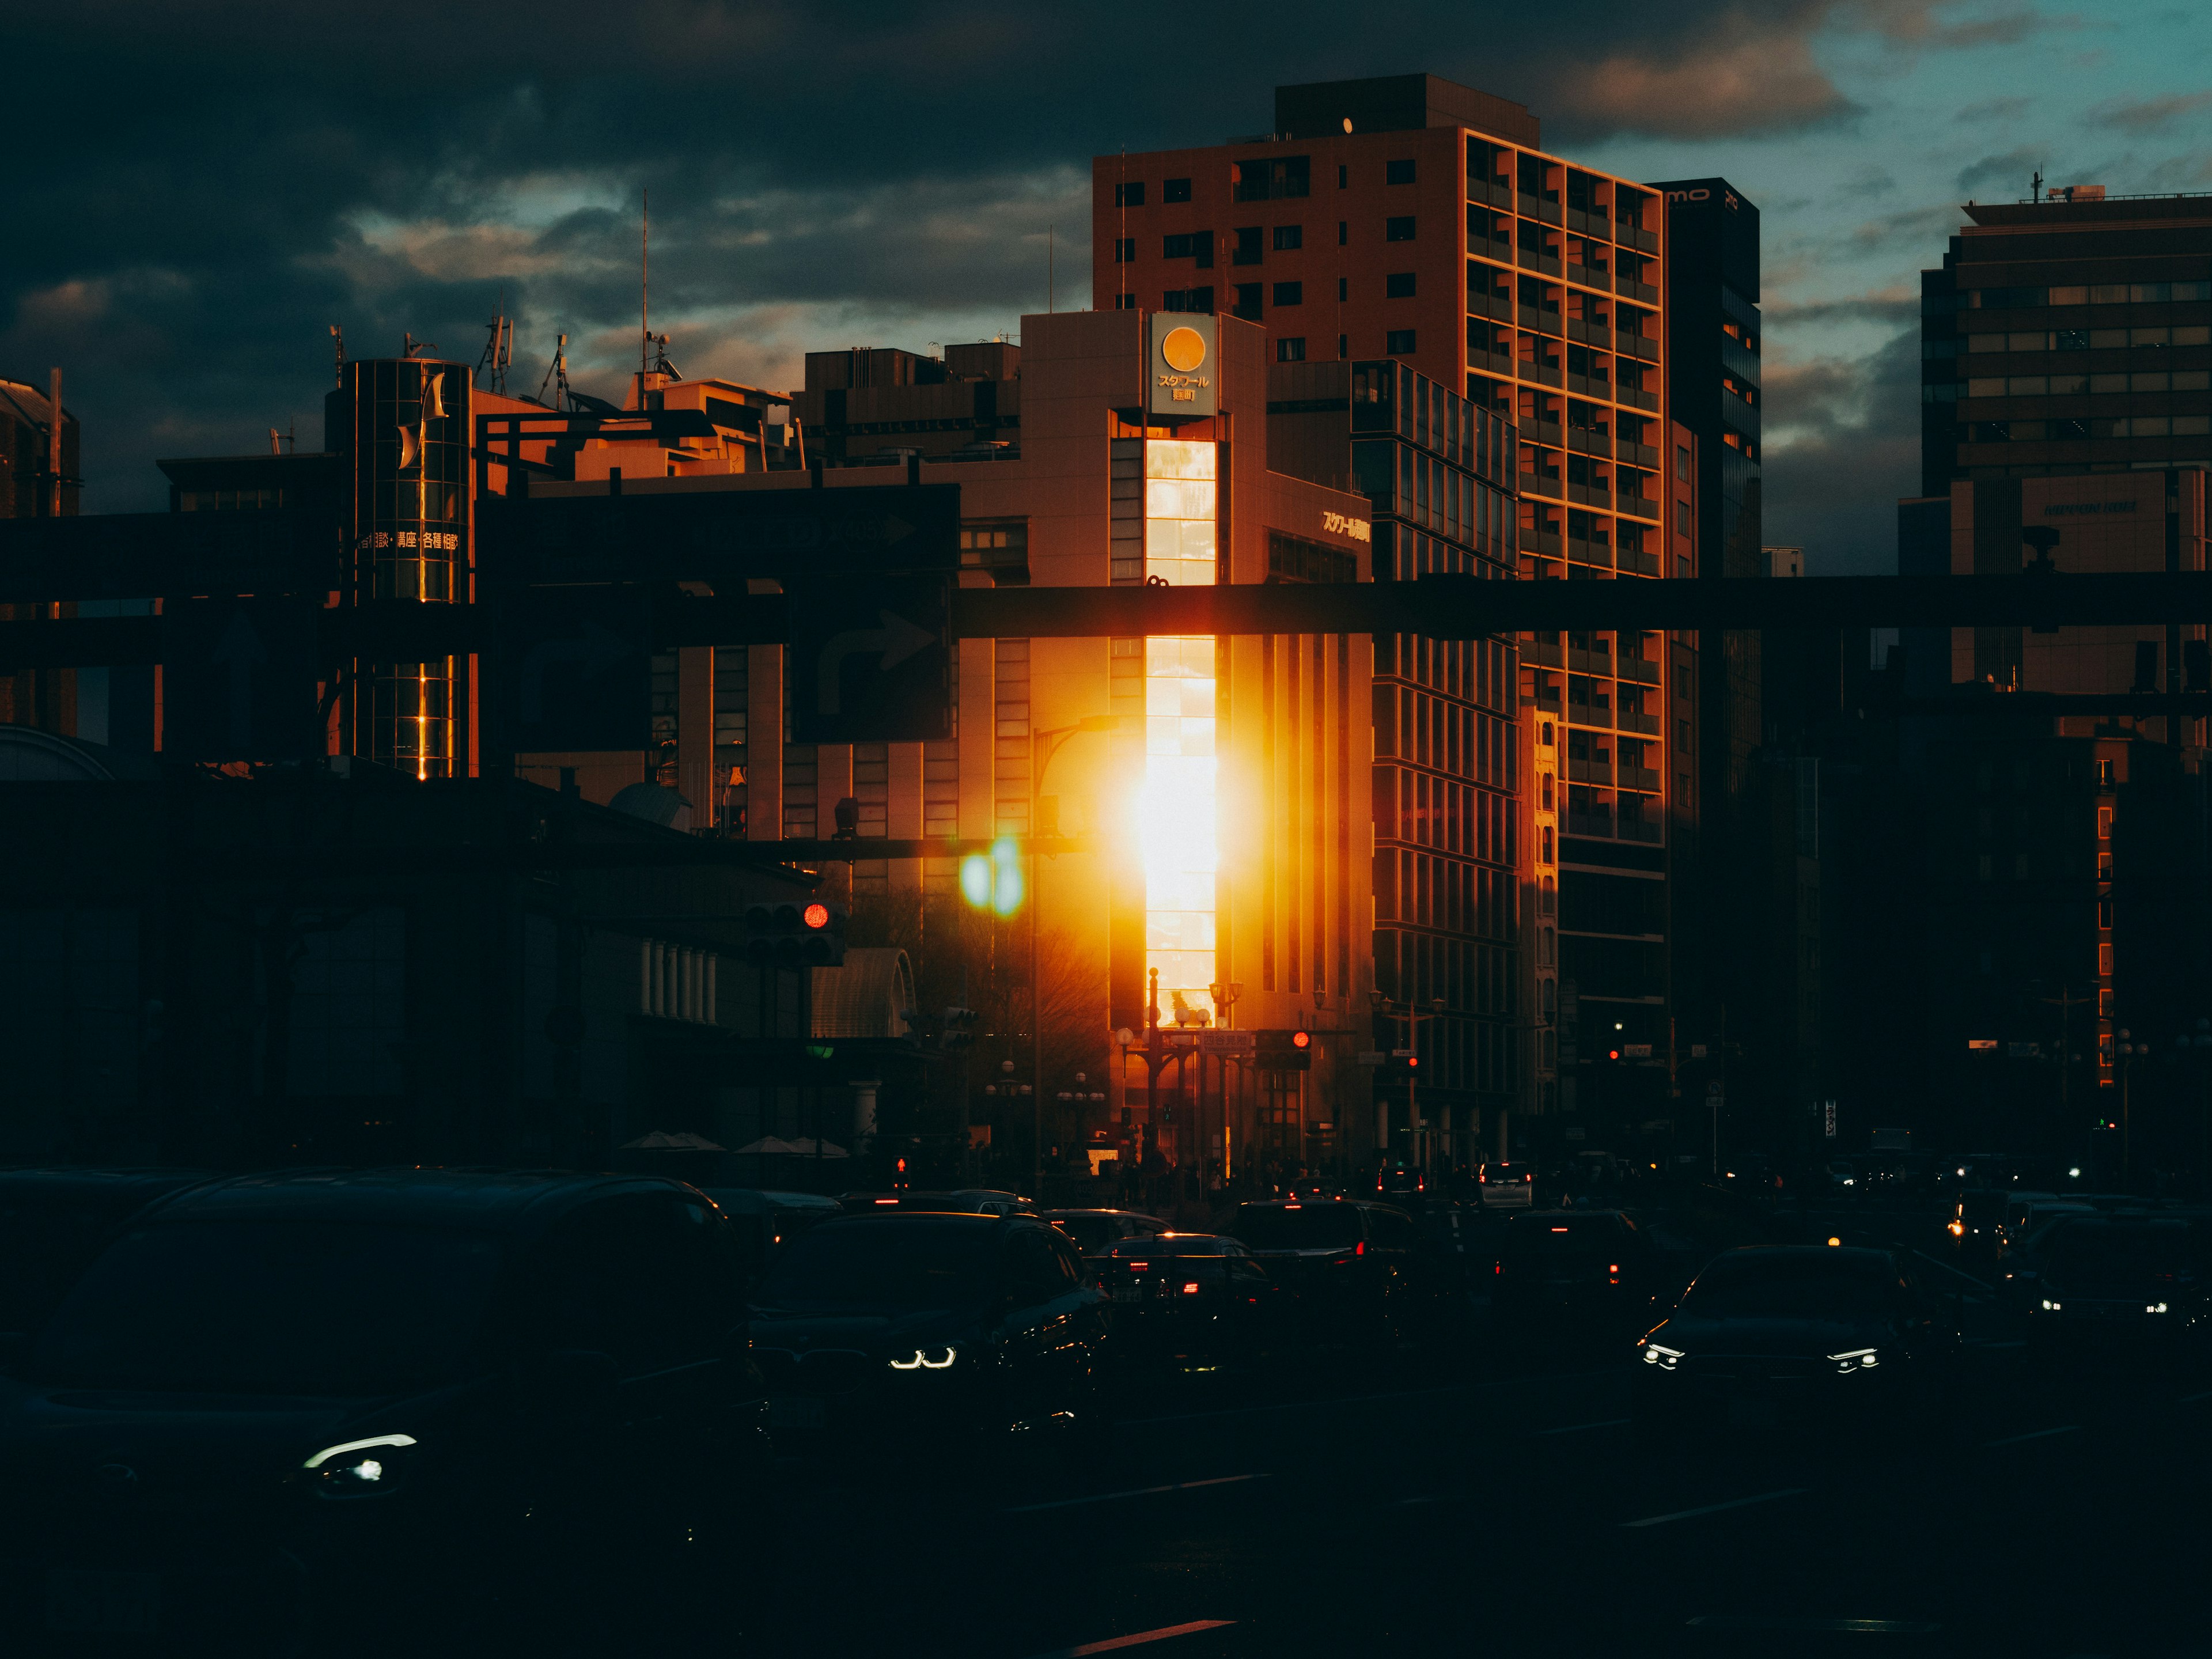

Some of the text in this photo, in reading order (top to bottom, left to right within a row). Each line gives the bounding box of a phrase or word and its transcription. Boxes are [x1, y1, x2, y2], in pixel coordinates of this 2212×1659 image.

[1158, 375, 1209, 388] スクワール
[844, 521, 878, 541] 405
